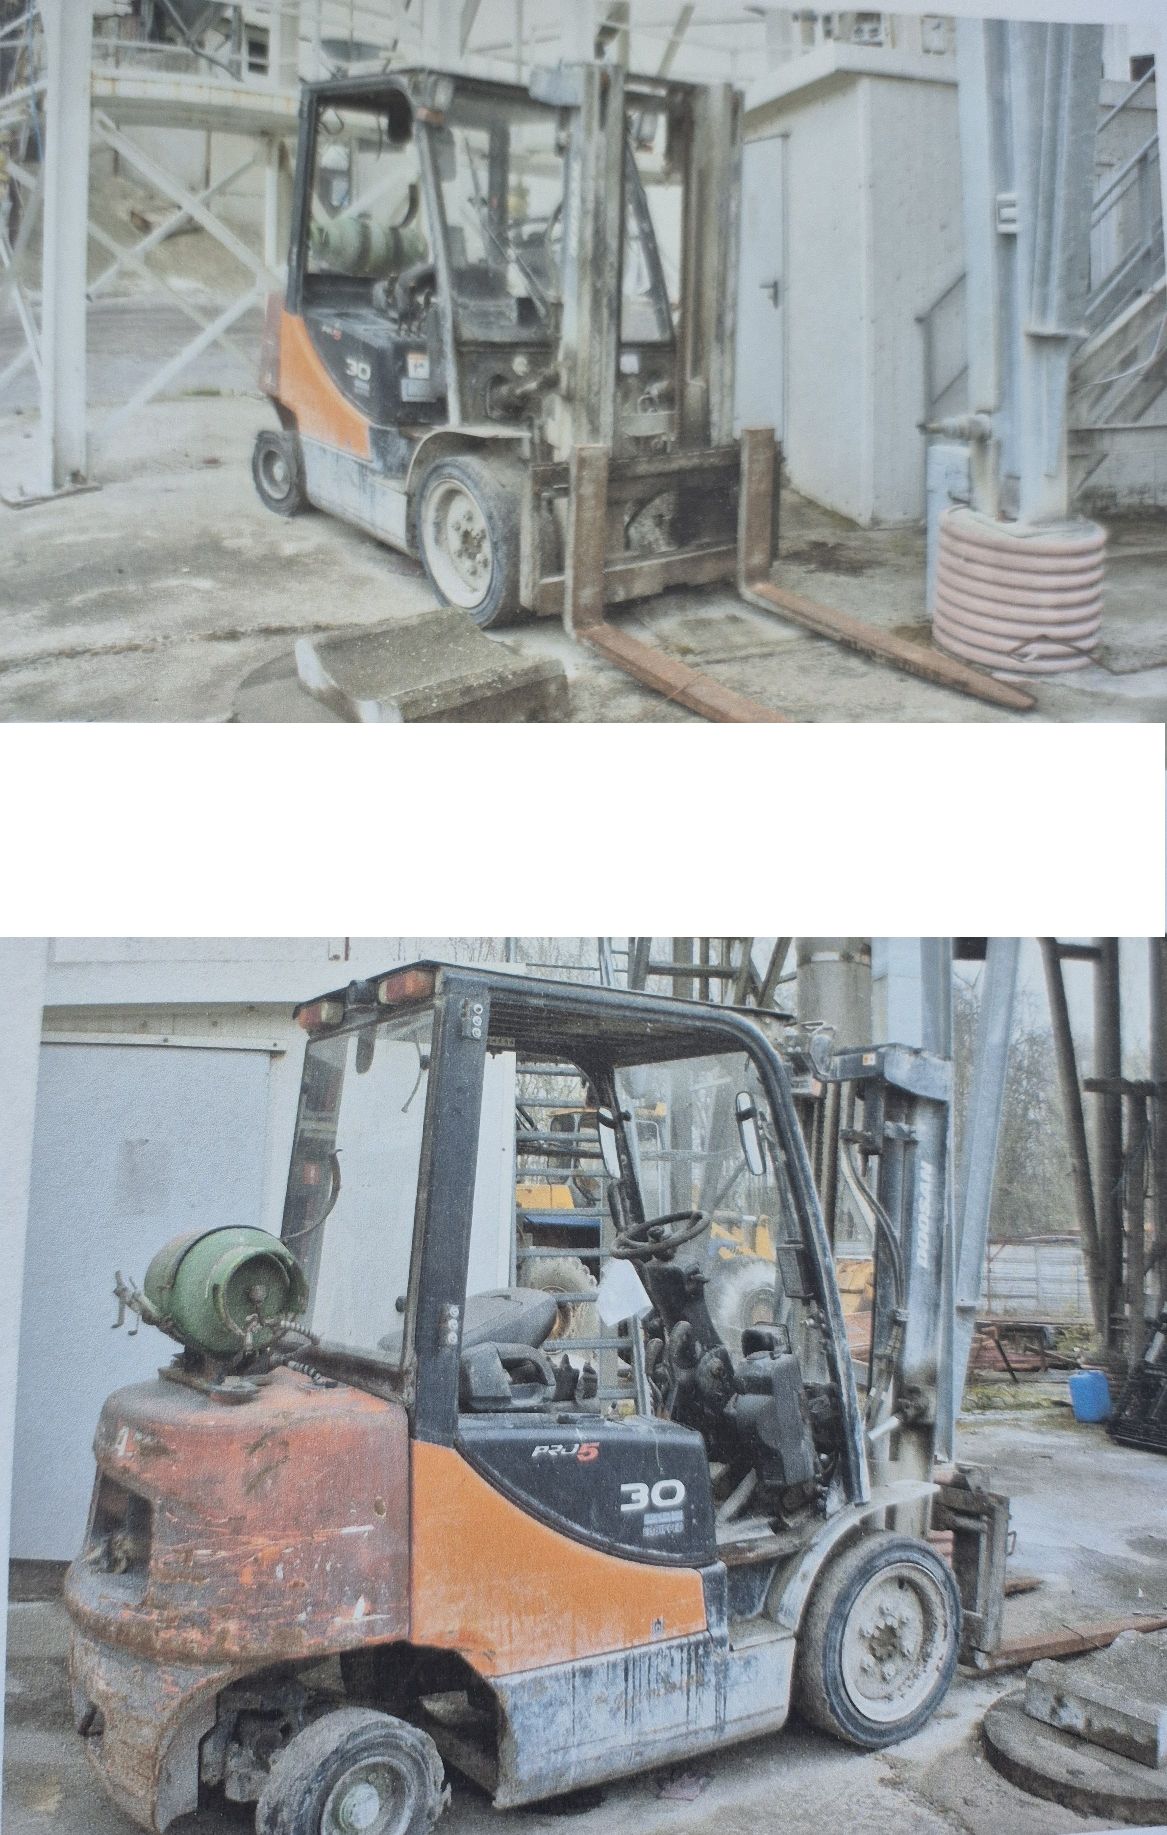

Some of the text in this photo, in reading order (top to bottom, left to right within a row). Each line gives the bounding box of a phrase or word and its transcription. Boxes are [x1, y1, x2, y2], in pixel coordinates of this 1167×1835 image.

[345, 358, 371, 380] 30
[917, 1161, 933, 1269] DOOSAN
[620, 1479, 685, 1511] 30
